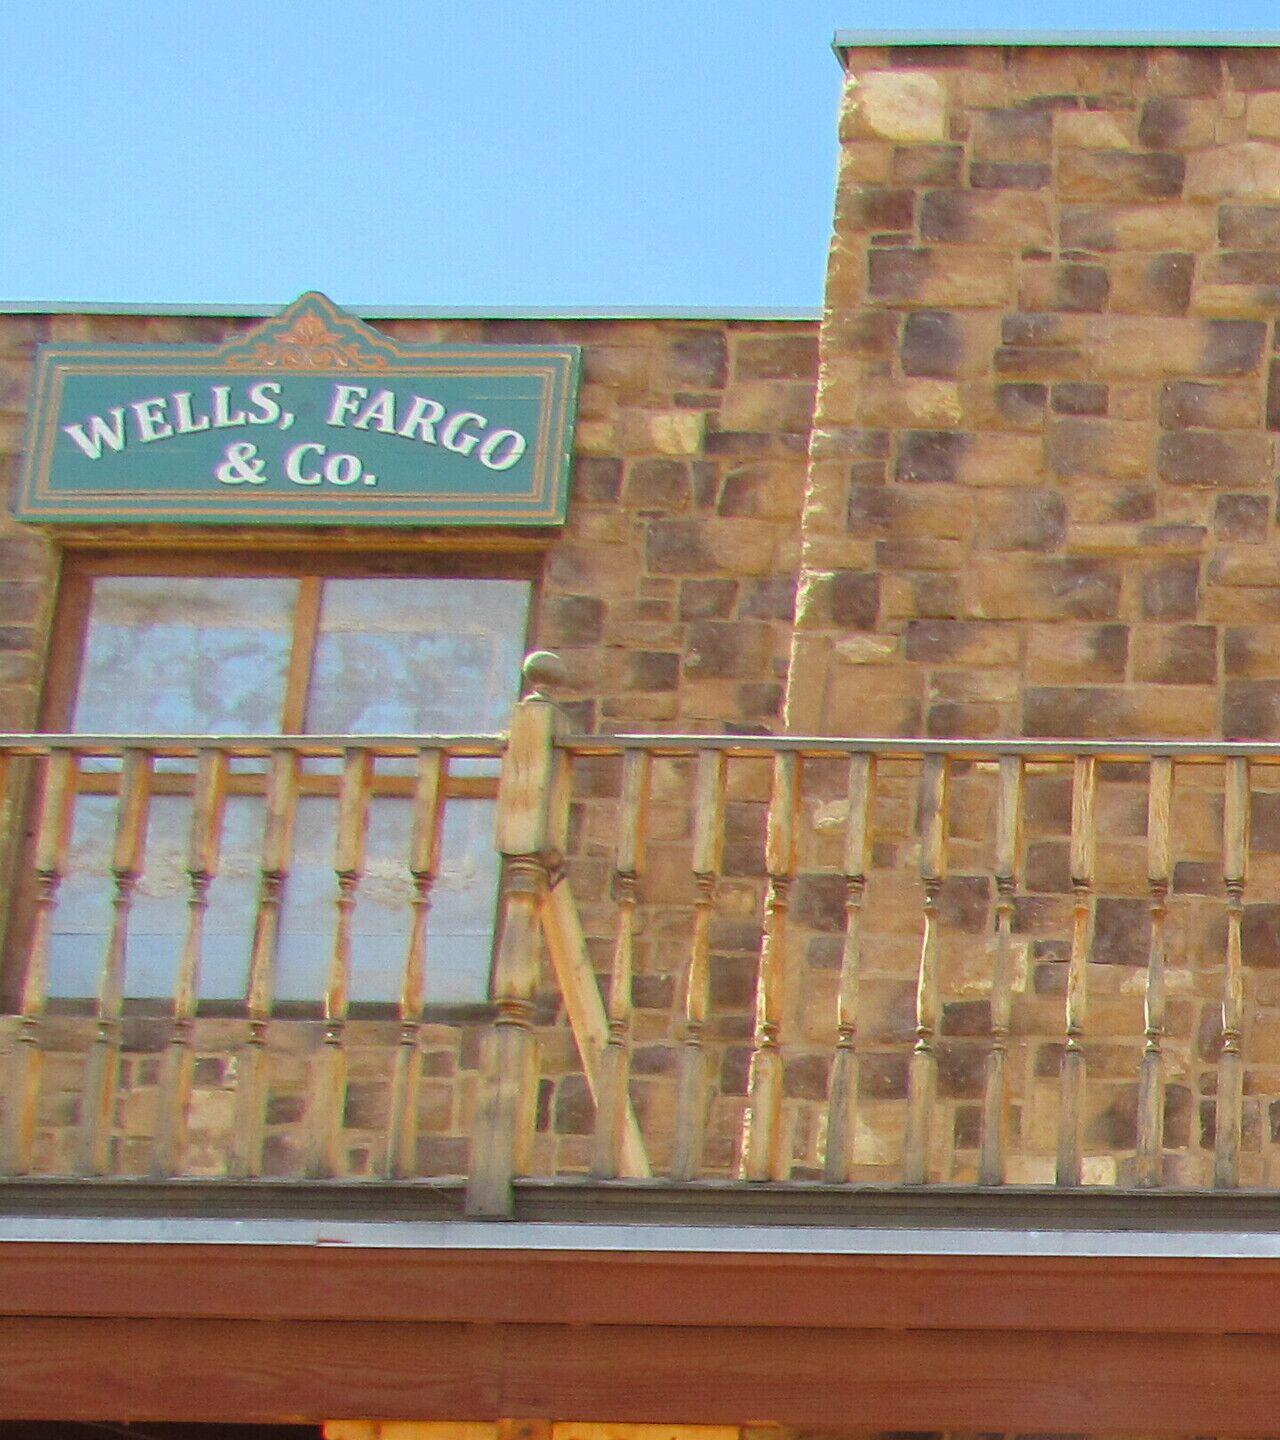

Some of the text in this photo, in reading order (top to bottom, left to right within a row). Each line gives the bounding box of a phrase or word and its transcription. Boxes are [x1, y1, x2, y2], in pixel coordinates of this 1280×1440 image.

[64, 382, 527, 471] WELLS, FARGO
[214, 441, 377, 486] & Co.
